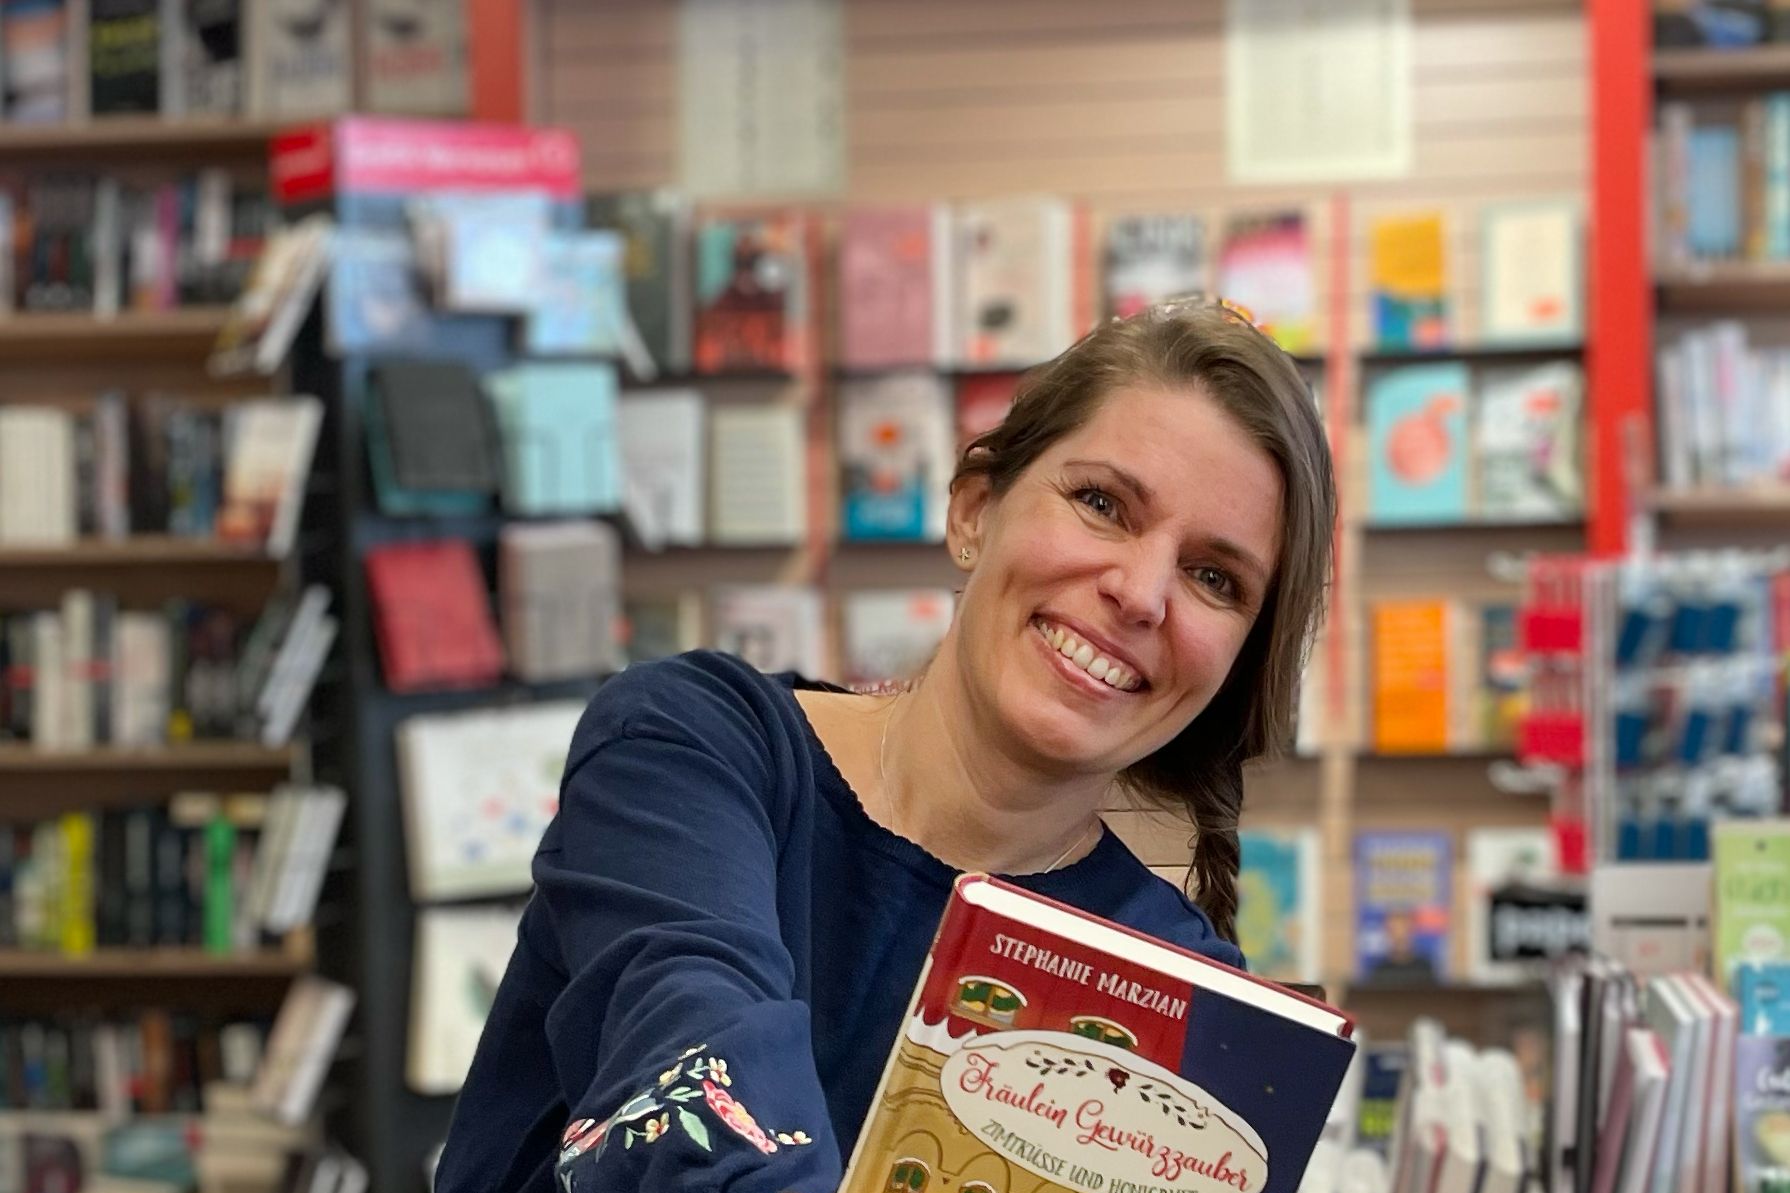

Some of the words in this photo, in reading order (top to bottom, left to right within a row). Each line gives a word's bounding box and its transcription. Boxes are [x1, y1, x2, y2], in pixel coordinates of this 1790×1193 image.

[989, 933, 1094, 985] STEPHANIE
[1096, 971, 1187, 1020] MARZIAN
[959, 1052, 1069, 1129] Fräulein
[1075, 1099, 1250, 1192] Gewürzzauber
[980, 1118, 1067, 1177] ZIMTKÜSSE
[1068, 1163, 1104, 1190] UND
